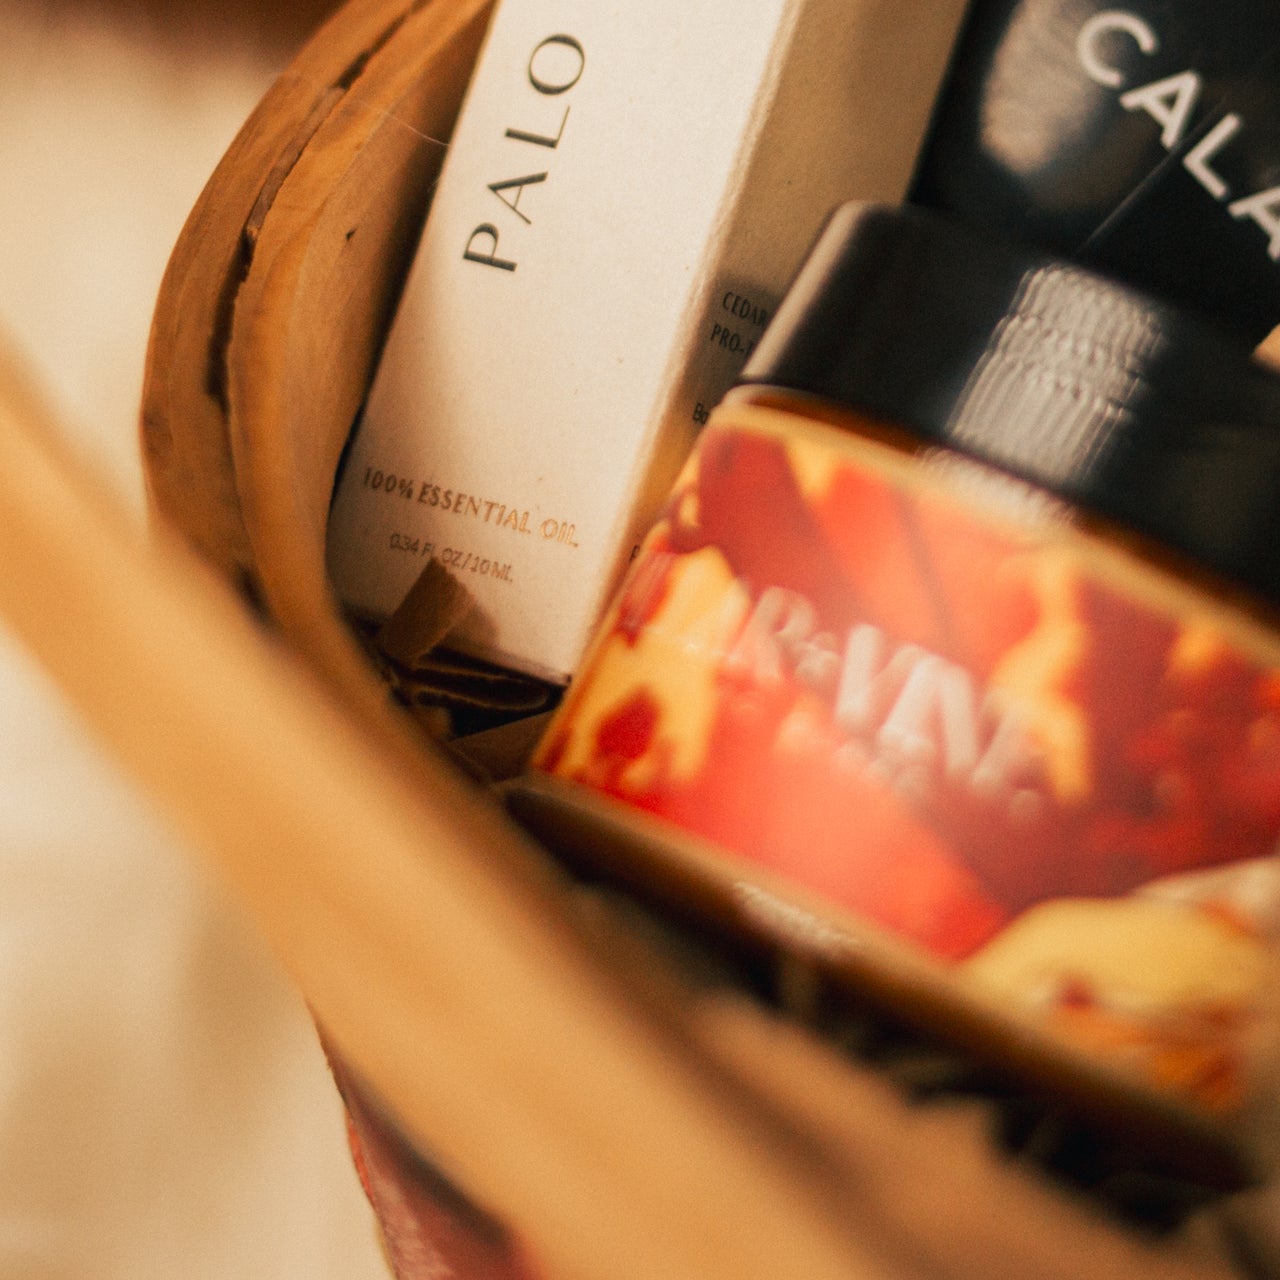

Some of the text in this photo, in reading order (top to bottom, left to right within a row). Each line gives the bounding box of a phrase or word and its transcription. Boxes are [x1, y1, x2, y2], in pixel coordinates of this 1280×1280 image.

[461, 32, 587, 273] PALO
[363, 467, 579, 549] 100% ESSENTIAL OIL
